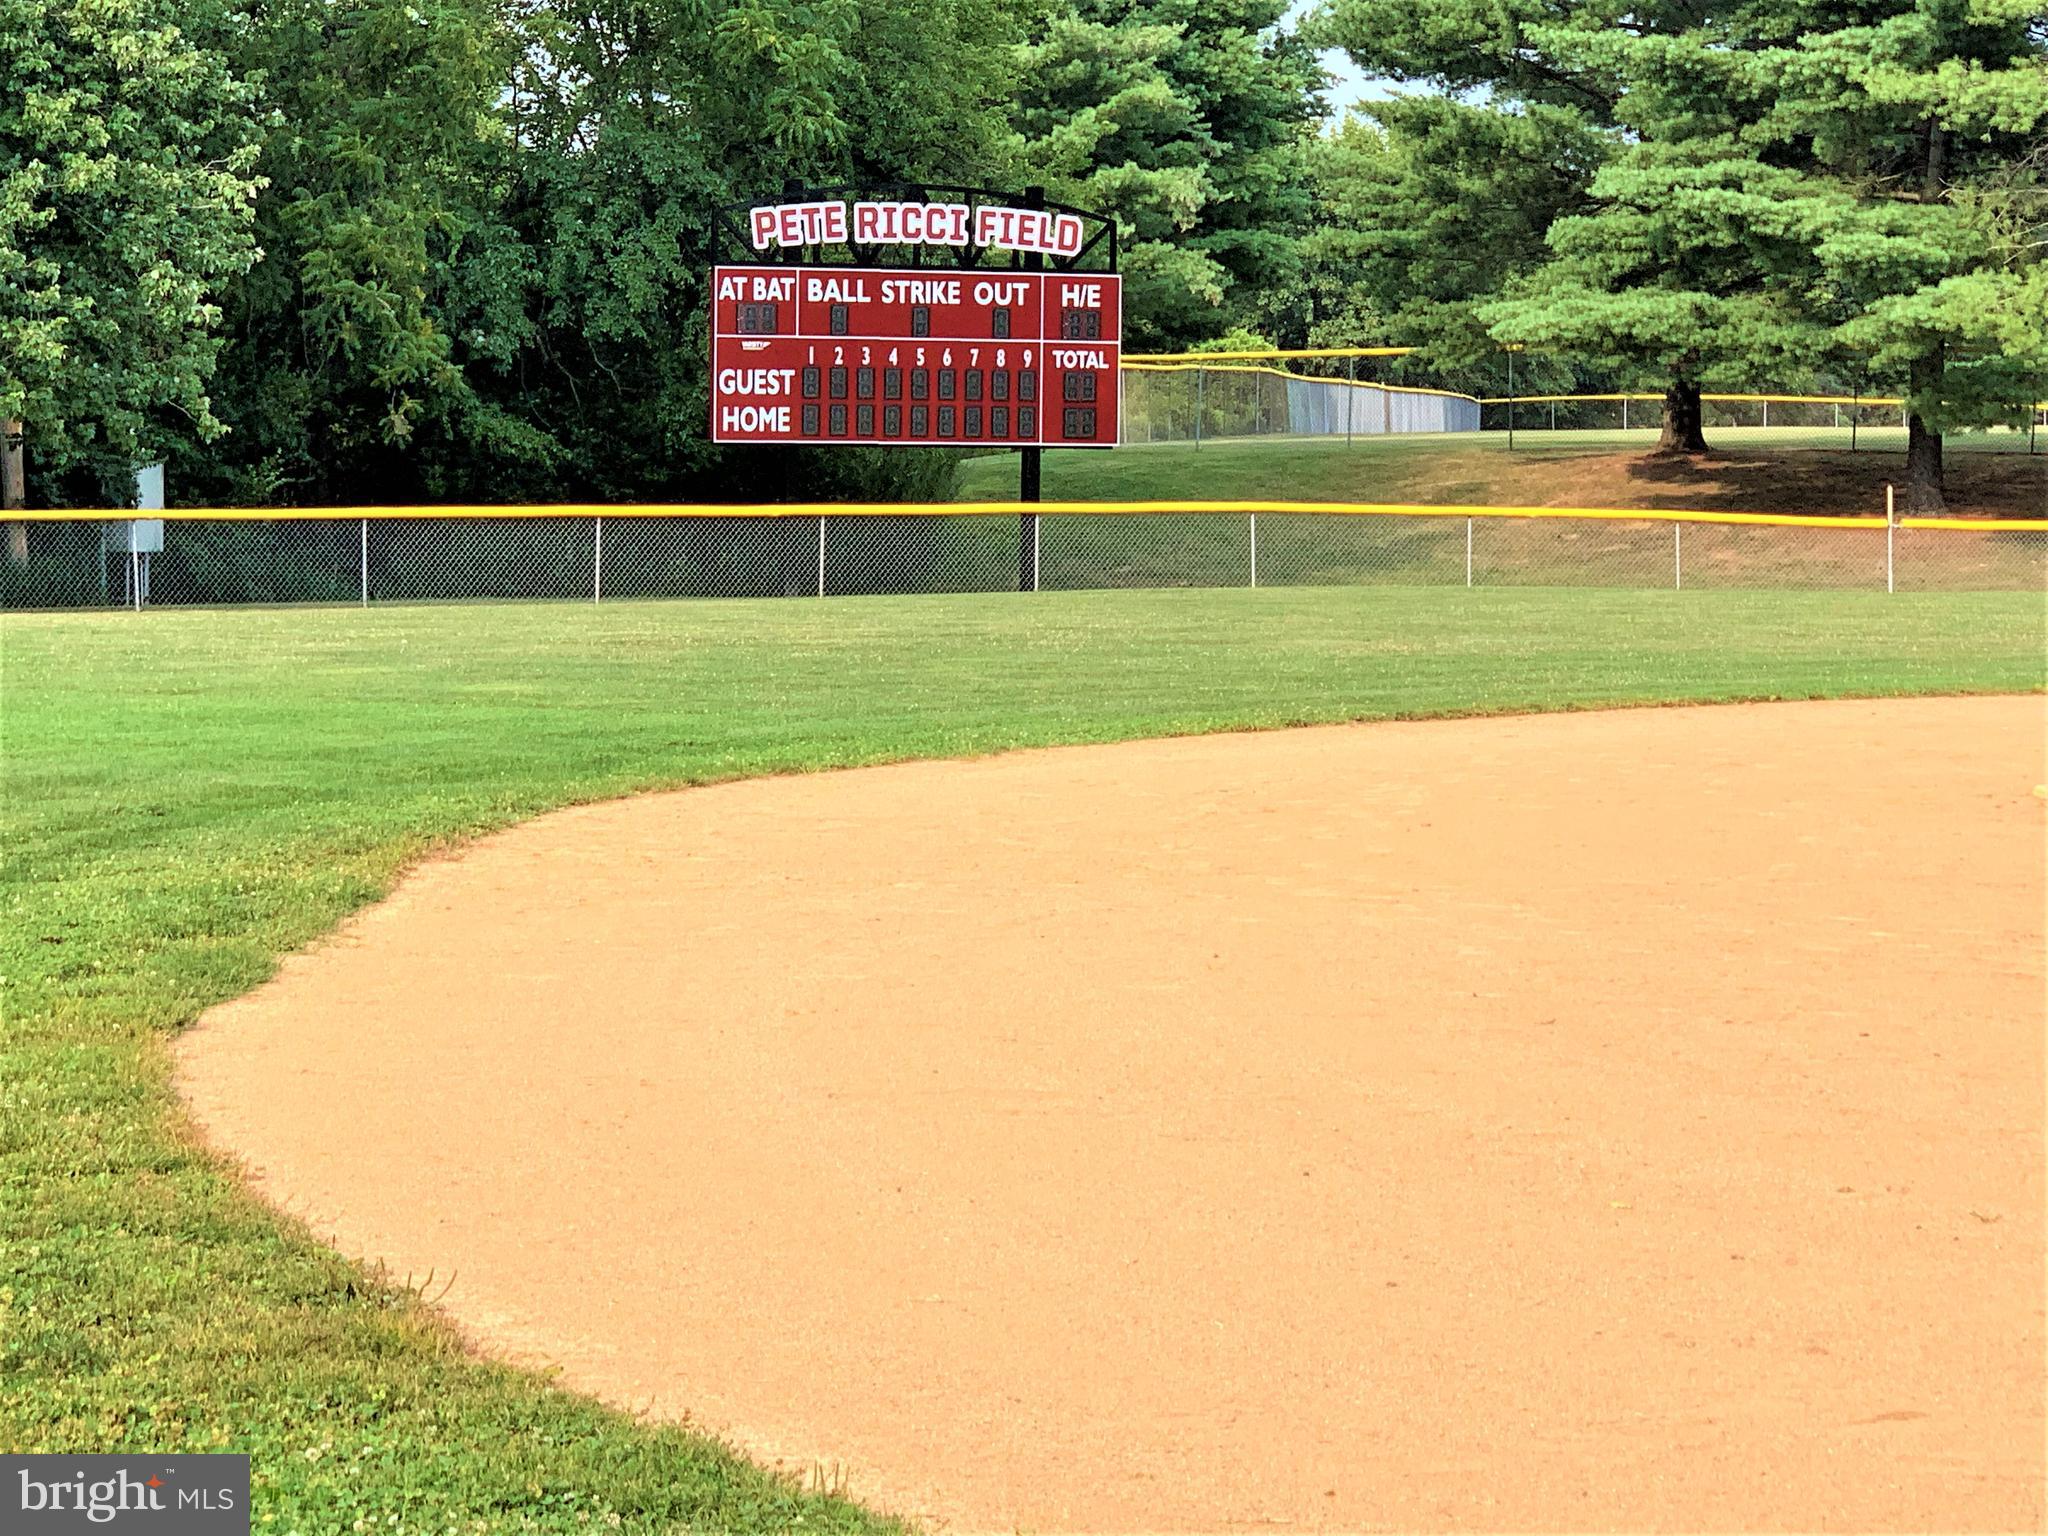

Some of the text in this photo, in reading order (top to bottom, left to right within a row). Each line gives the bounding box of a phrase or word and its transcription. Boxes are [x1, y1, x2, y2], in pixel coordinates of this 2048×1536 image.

[753, 205, 1080, 252] PETE RICCI FIELD
[719, 277, 795, 301] AT BAT
[808, 279, 871, 302] BALL
[882, 281, 961, 304] STRIKE
[974, 283, 1030, 305] OUT
[1062, 285, 1101, 307] H/E
[809, 346, 1033, 367] 1 2 3 4 5 6 7 8 9
[1052, 350, 1109, 369] TOTAL
[719, 369, 795, 395] GUEST
[722, 406, 790, 432] HOME
